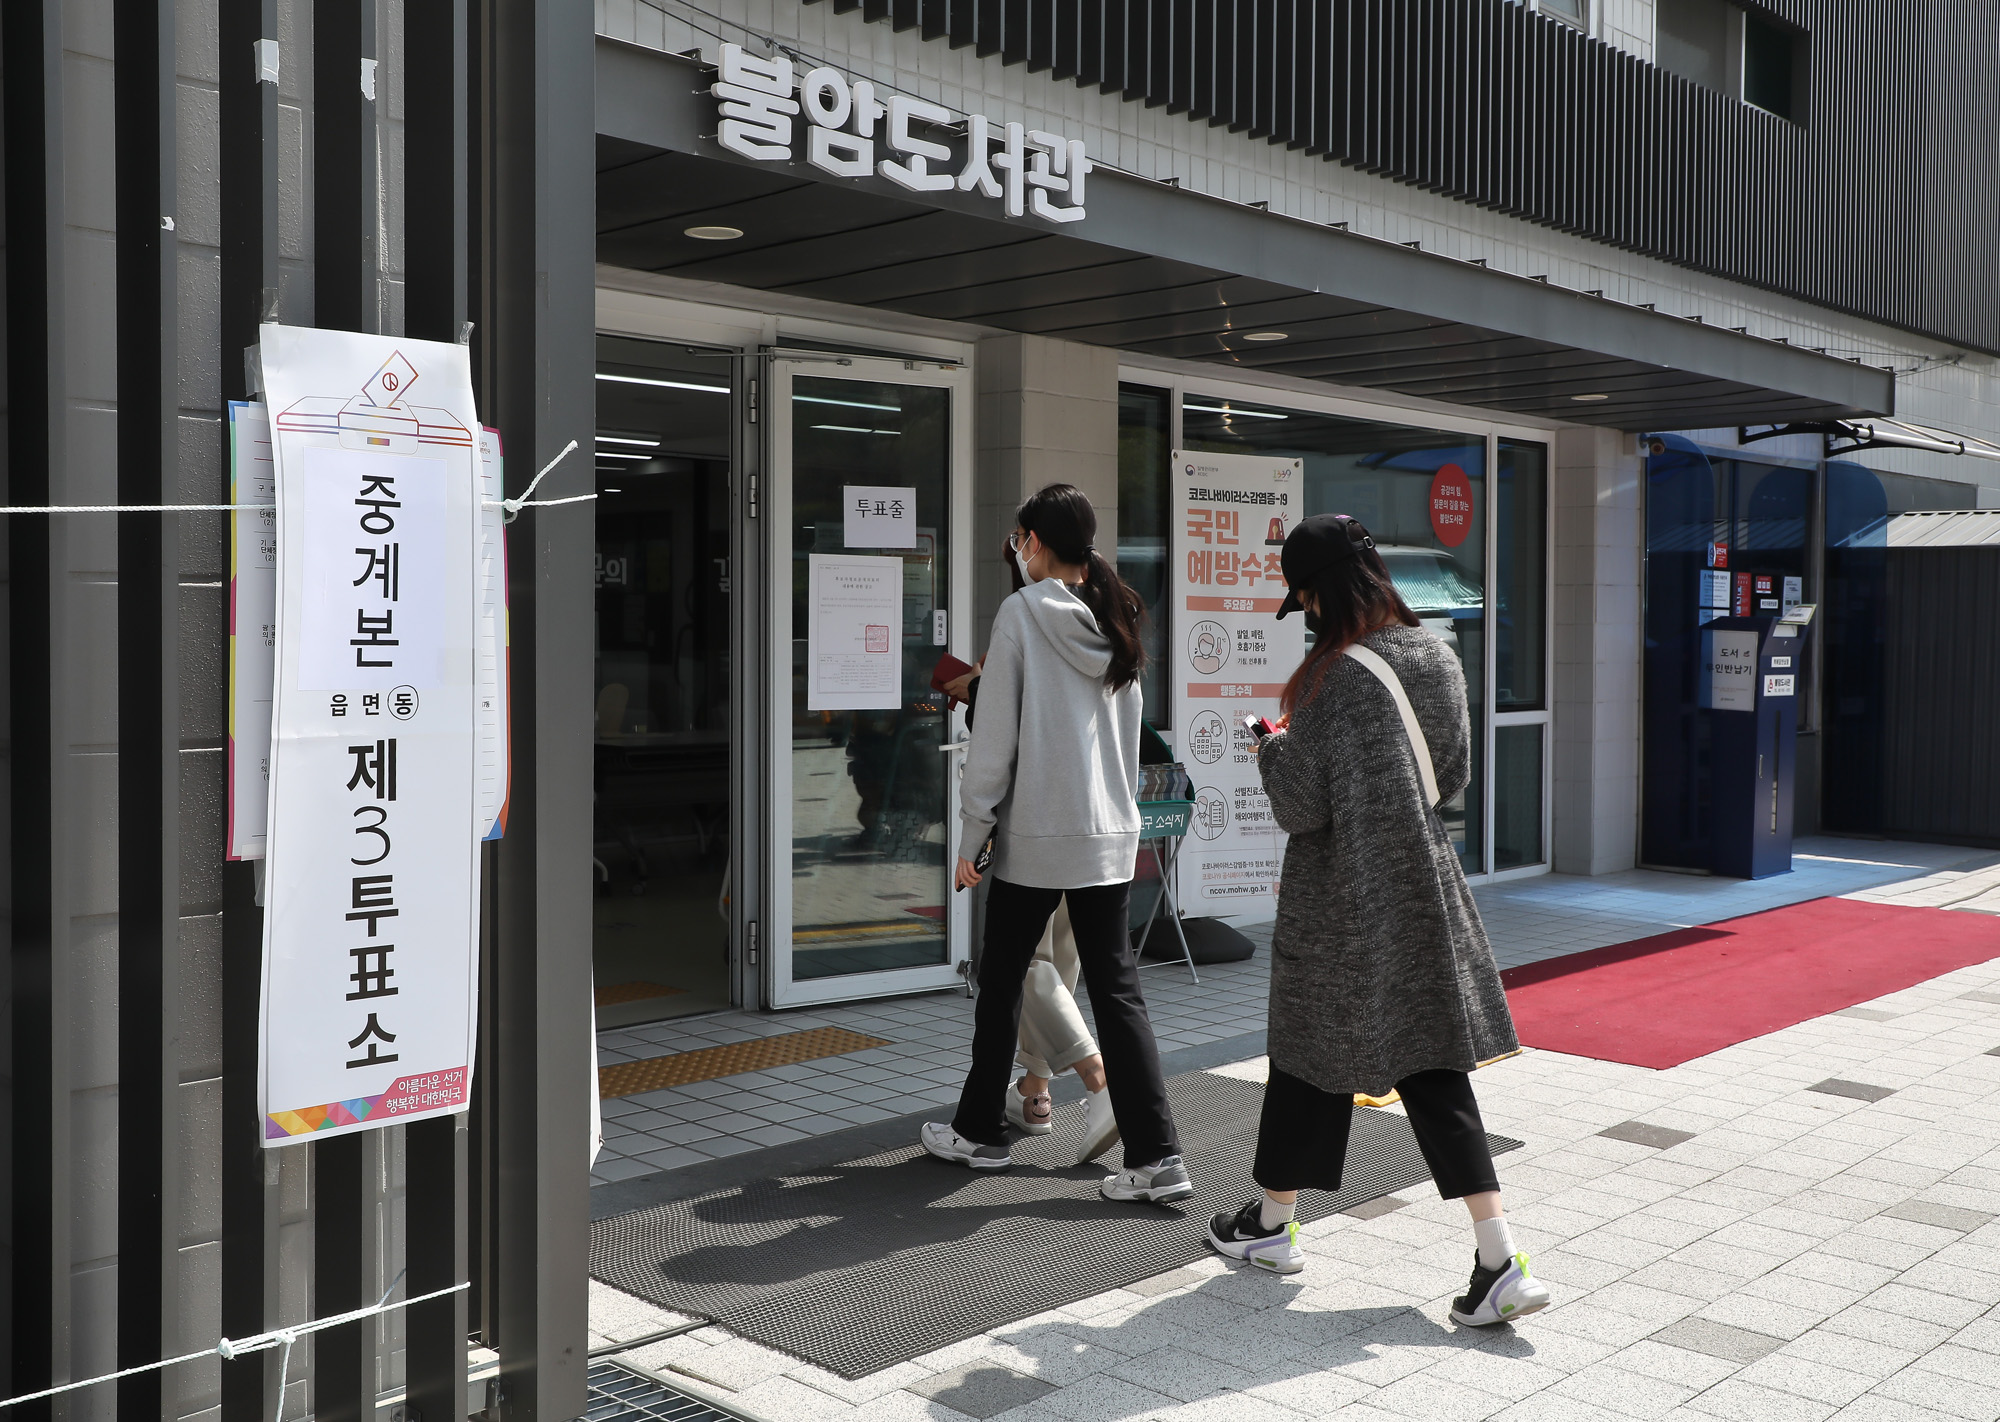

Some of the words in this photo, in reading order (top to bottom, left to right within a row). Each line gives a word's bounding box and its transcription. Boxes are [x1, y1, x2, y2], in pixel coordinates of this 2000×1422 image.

[711, 43, 1093, 223] 불암도서관
[1273, 469, 1292, 479] 1339
[1188, 487, 1288, 506] 코로나바이러스감염증-19
[855, 499, 905, 519] 투표줄
[1187, 508, 1239, 545] 국민
[1440, 513, 1464, 525] 불암도서관
[349, 474, 402, 668] 중계본
[1223, 599, 1254, 611] 주요증상
[1237, 642, 1266, 652] 호흡기증상
[1720, 648, 1739, 659] 도서
[1220, 685, 1252, 696] 행동수칙
[330, 693, 348, 717] 읍
[362, 692, 381, 717] 면
[391, 690, 416, 718] 동
[1233, 754, 1248, 764] 1339
[1234, 799, 1247, 809] 방문
[1155, 813, 1184, 829] 소식지
[1209, 884, 1268, 895] ncov.mohw.go.kr
[345, 738, 399, 1070] 제3투표소
[398, 1074, 441, 1094] 아름다운
[442, 1069, 463, 1087] 선거
[386, 1094, 420, 1114] 행복한
[421, 1086, 462, 1106] 대한민국
